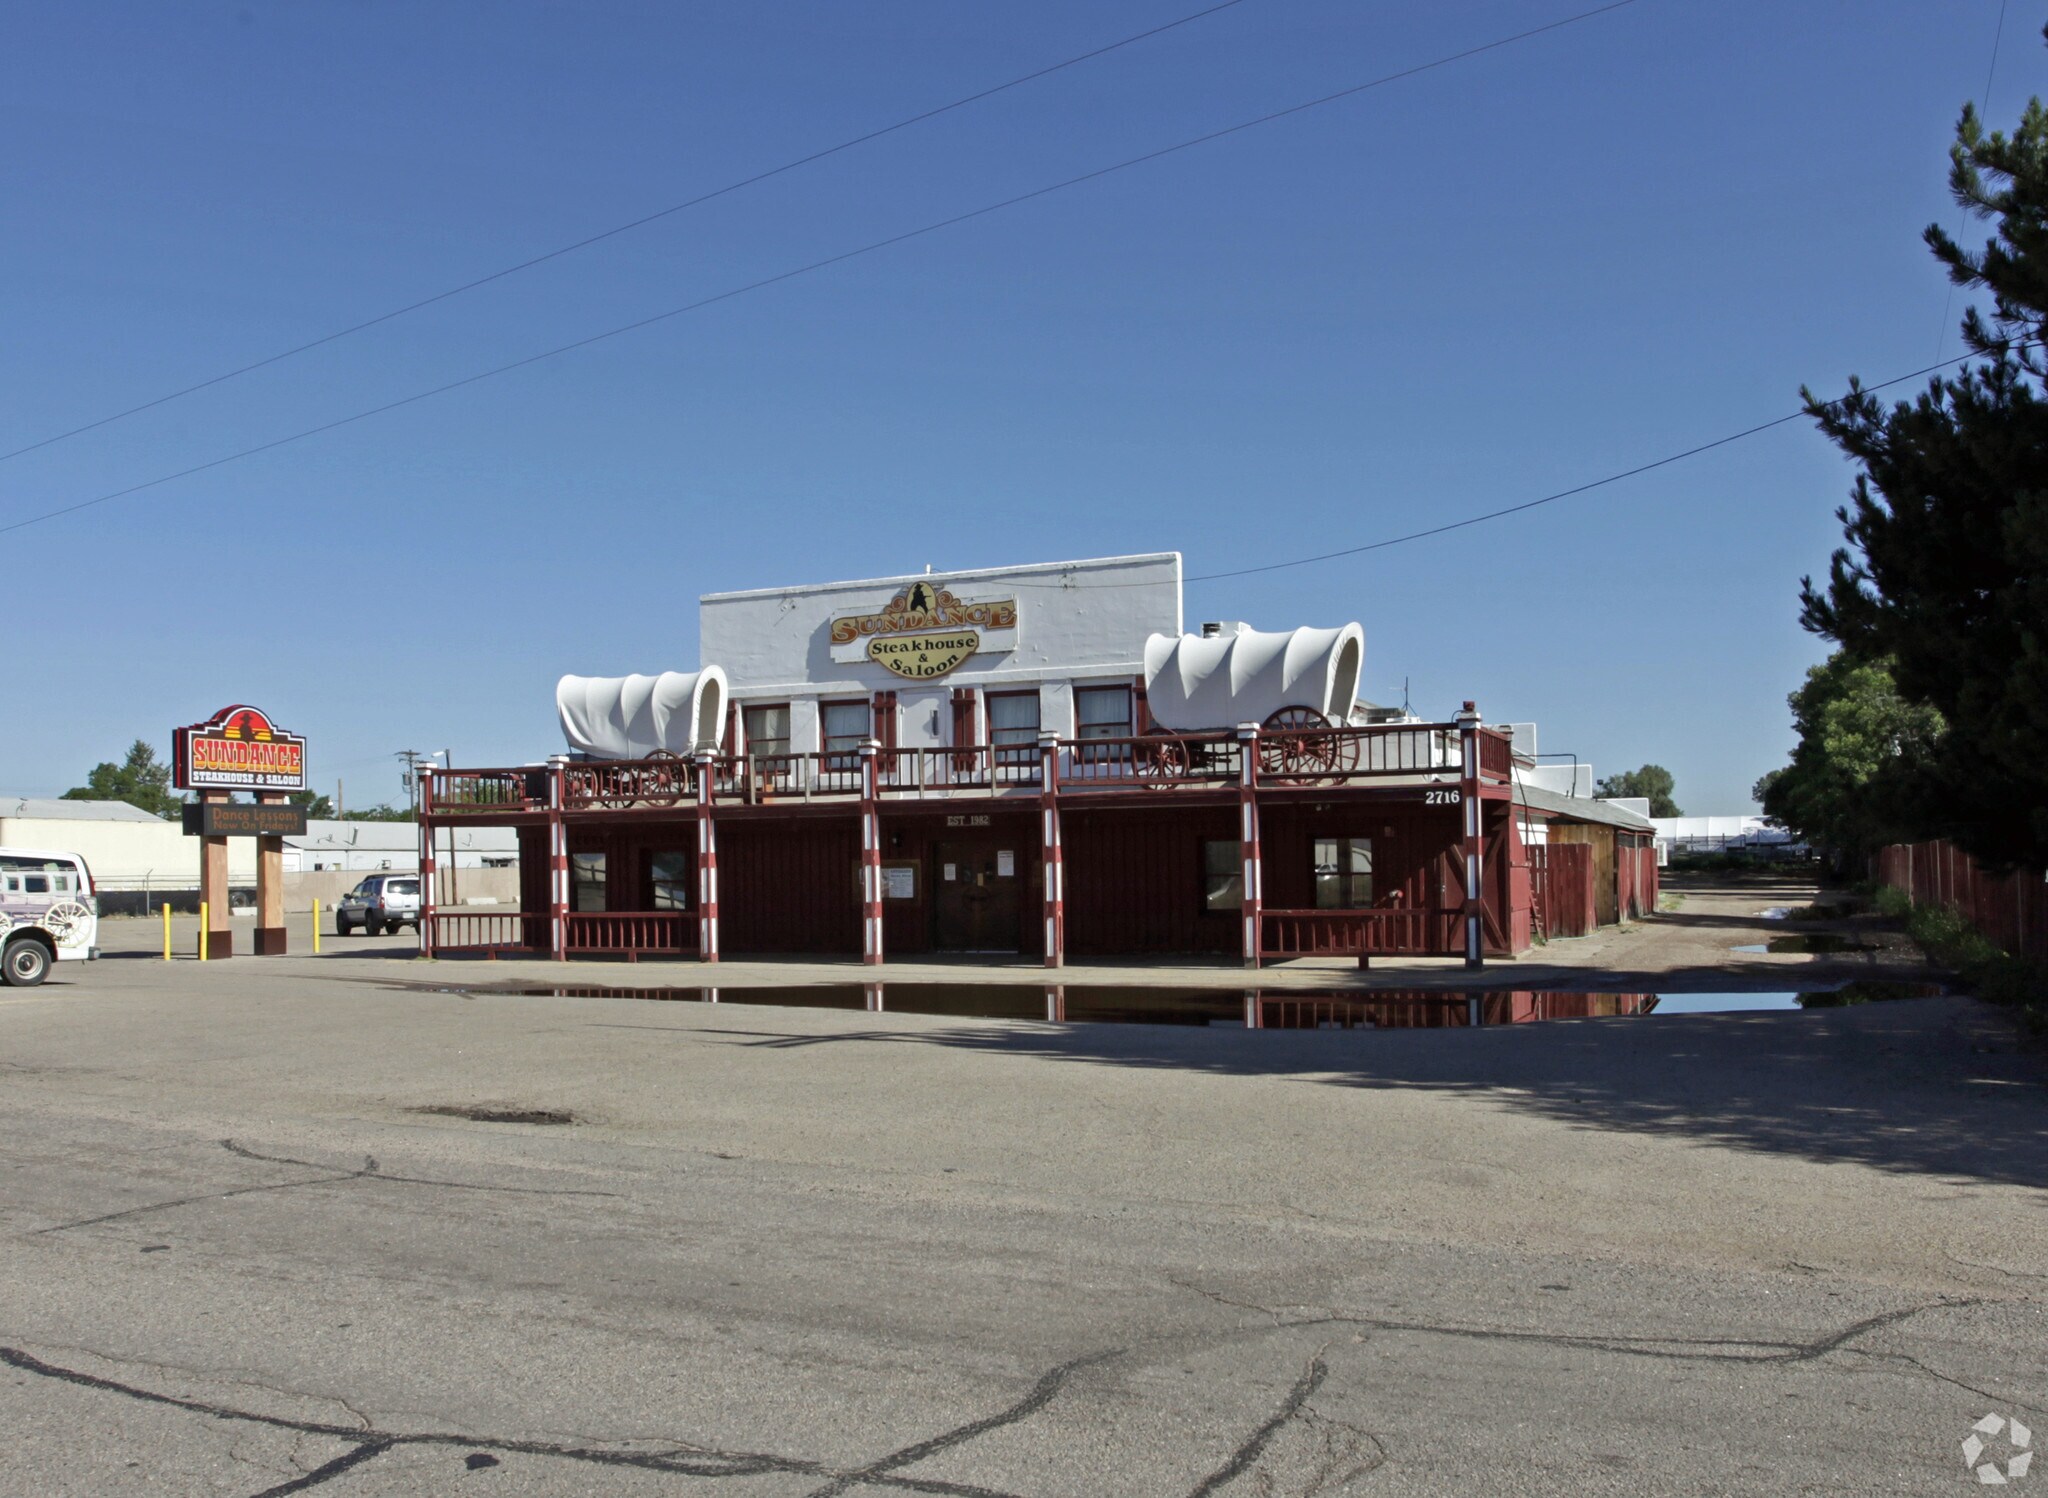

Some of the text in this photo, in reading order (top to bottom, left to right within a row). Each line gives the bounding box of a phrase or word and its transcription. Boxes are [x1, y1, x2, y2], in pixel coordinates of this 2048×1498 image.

[831, 599, 1017, 644] SUNDANCE
[872, 637, 975, 655] Steakhouse
[890, 654, 959, 676] Saloon
[918, 653, 928, 662] &
[193, 737, 301, 775] SUNDANCE
[193, 771, 301, 786] STEAKHOUSE & SALOON
[1425, 790, 1460, 804] 2716
[213, 807, 299, 822] Dance Lessons
[947, 815, 965, 827] EST
[214, 821, 298, 832] Now On Fridays!
